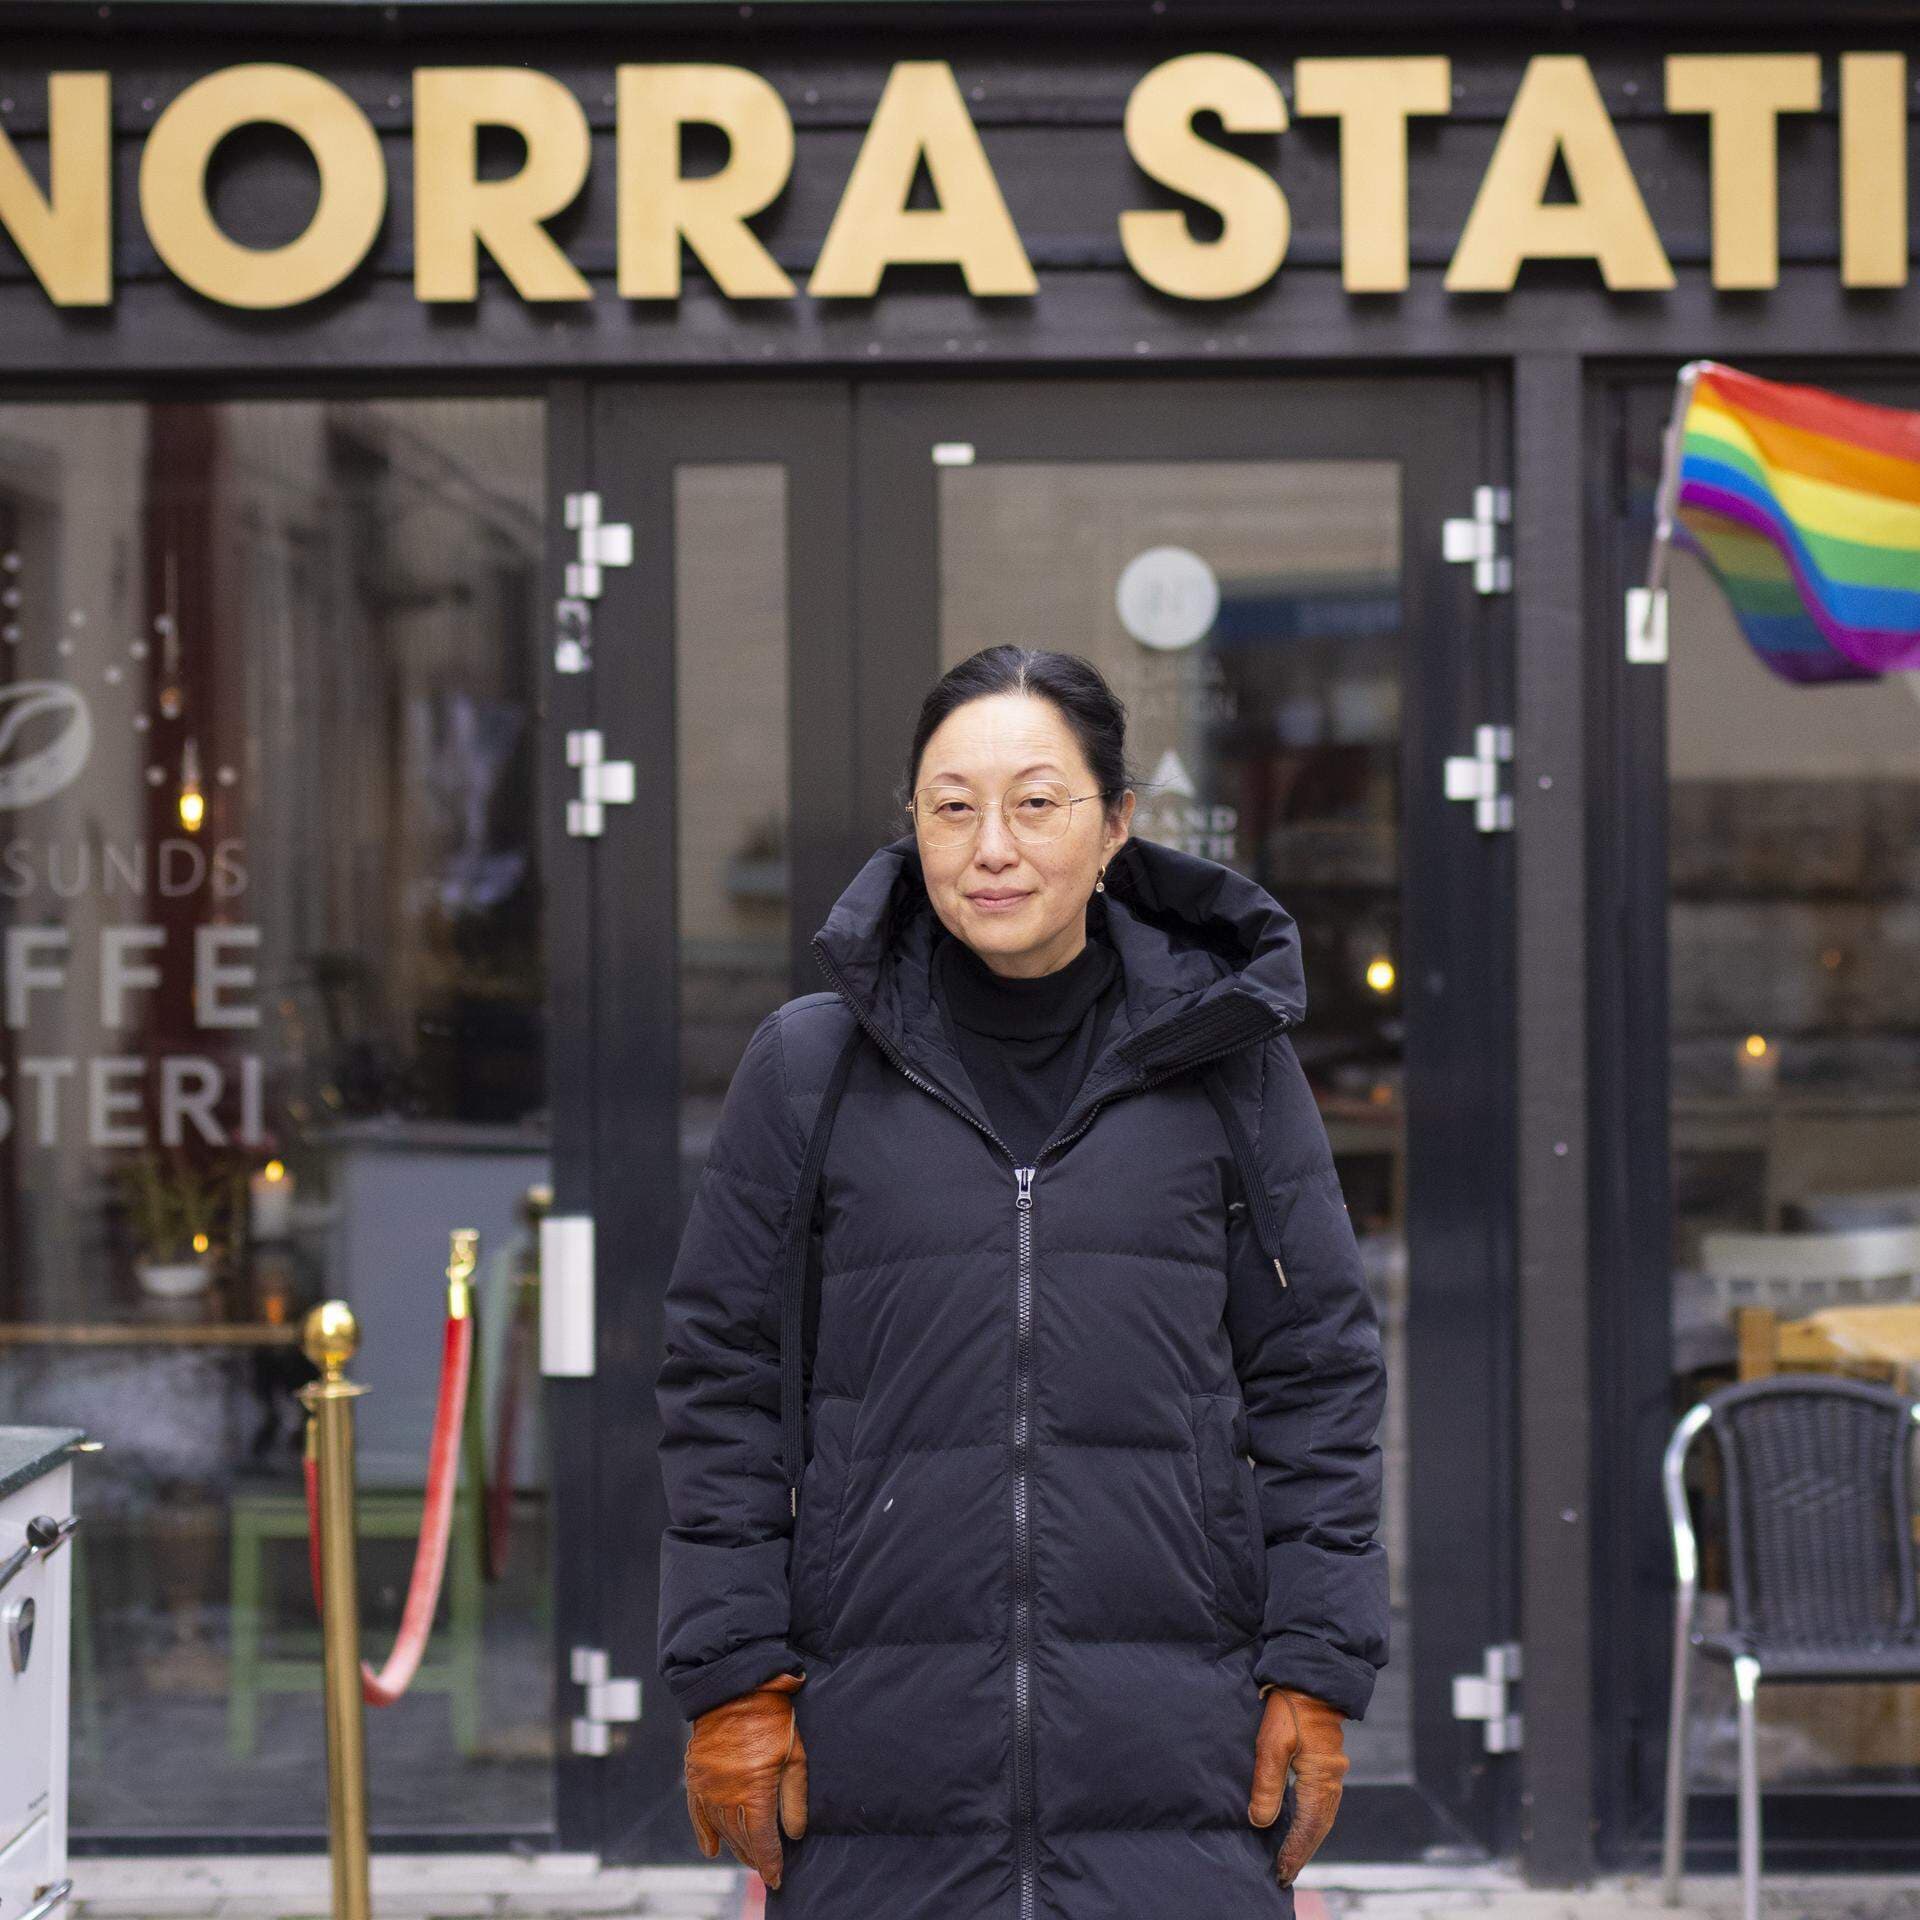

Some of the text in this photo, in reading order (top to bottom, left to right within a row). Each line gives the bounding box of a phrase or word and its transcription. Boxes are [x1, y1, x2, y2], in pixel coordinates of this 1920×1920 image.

[1119, 52, 1906, 300] STATI
[5, 926, 261, 1030] FFE
[0, 1055, 264, 1147] TERI
